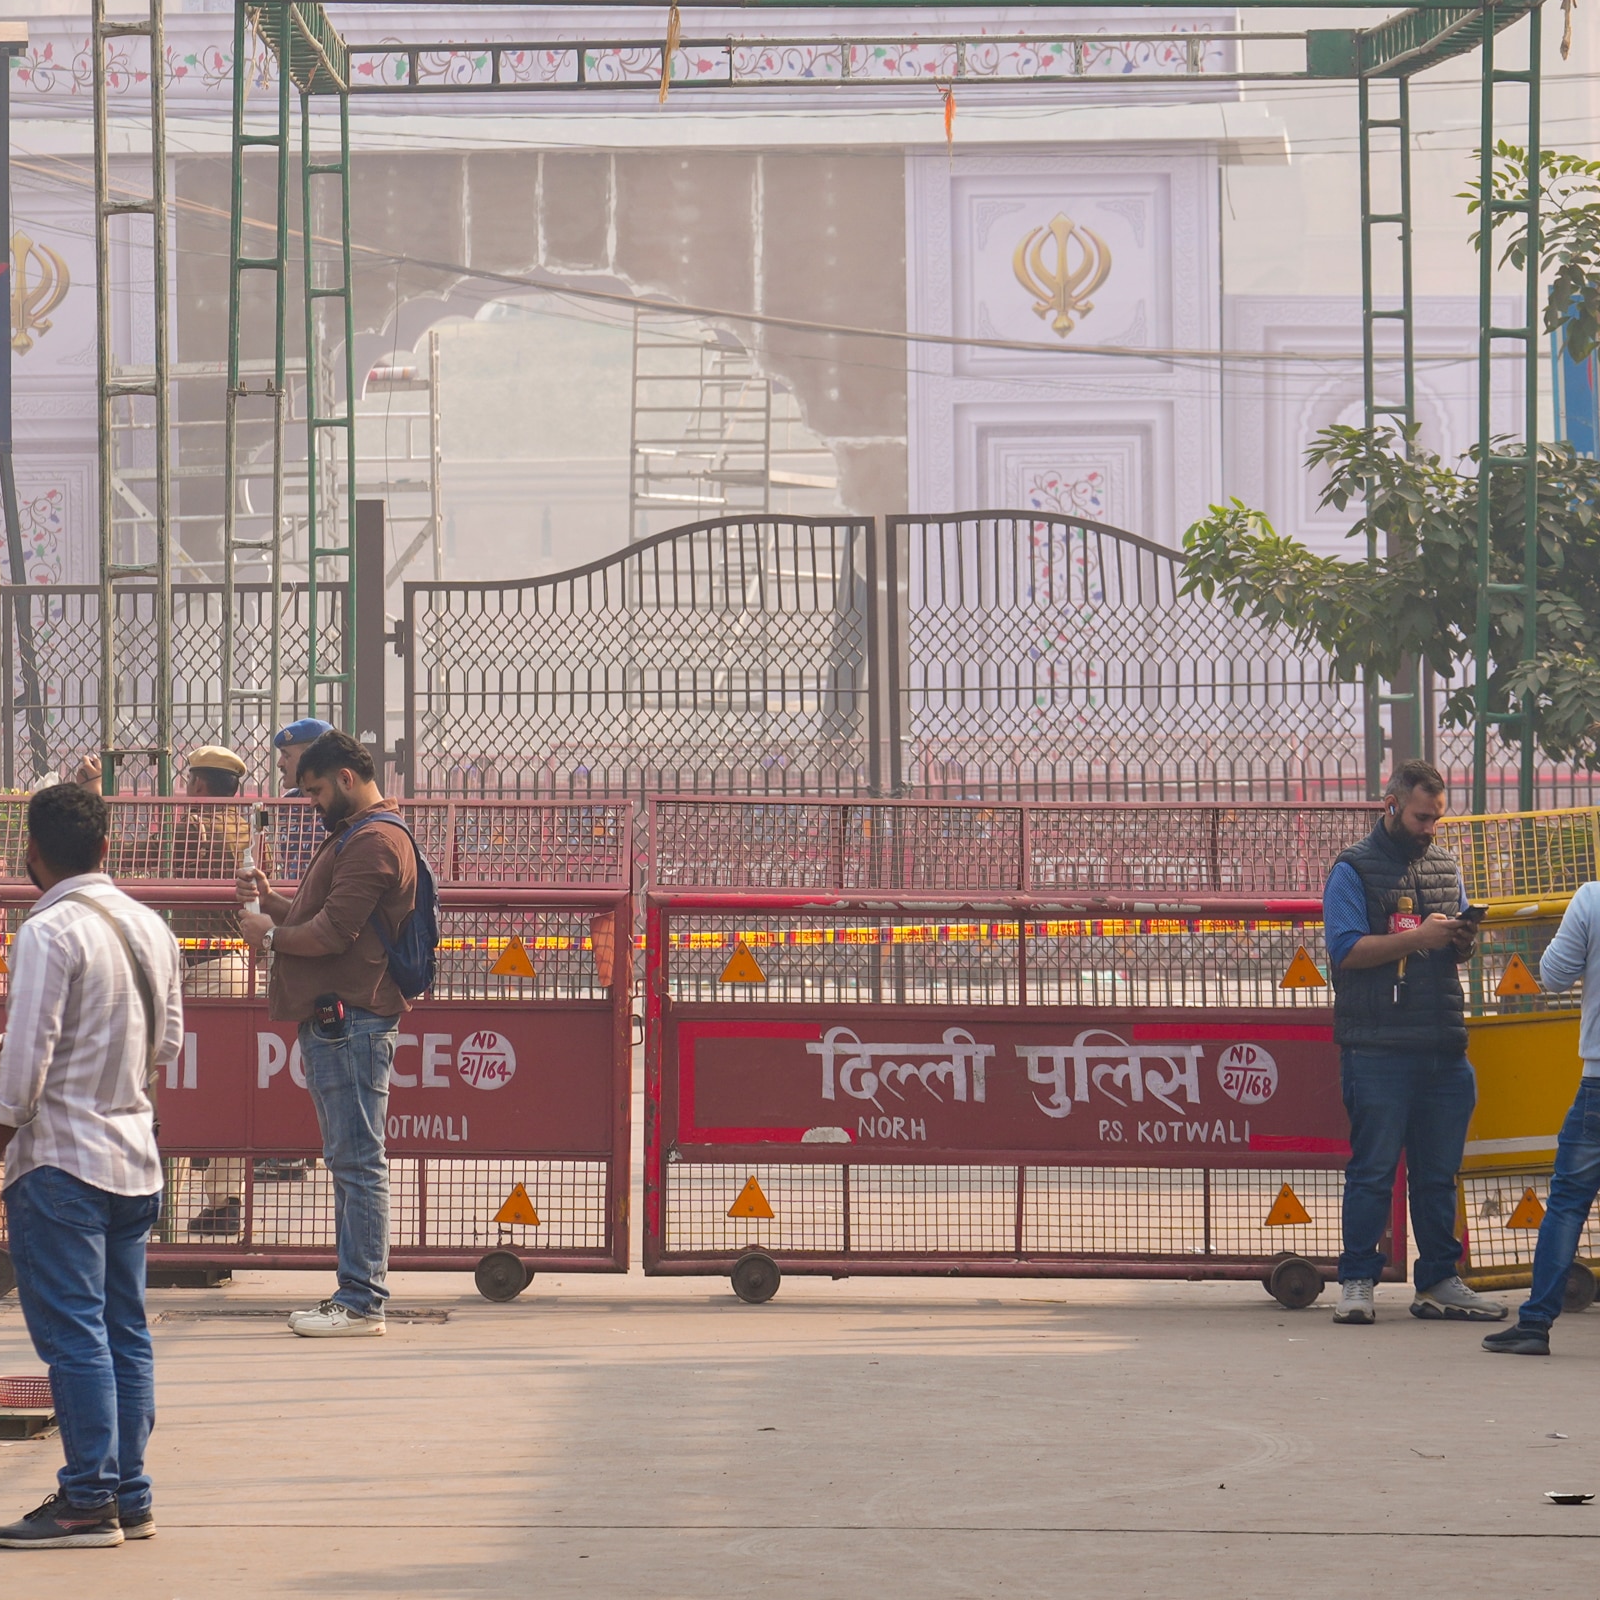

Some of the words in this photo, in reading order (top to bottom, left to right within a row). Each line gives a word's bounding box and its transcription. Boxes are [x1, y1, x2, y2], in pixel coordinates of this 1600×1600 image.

[1398, 921, 1418, 929] TODAY
[472, 1030, 498, 1050] ND
[1229, 1044, 1257, 1064] ND
[458, 1052, 512, 1087] 21/164
[805, 1026, 996, 1113] दिल्ली
[1014, 1029, 1205, 1119] पुलिस
[1223, 1069, 1273, 1102] 21/168
[387, 1114, 468, 1142] OTWALI
[858, 1115, 927, 1142] NORH
[1137, 1118, 1251, 1145] KOTWALI
